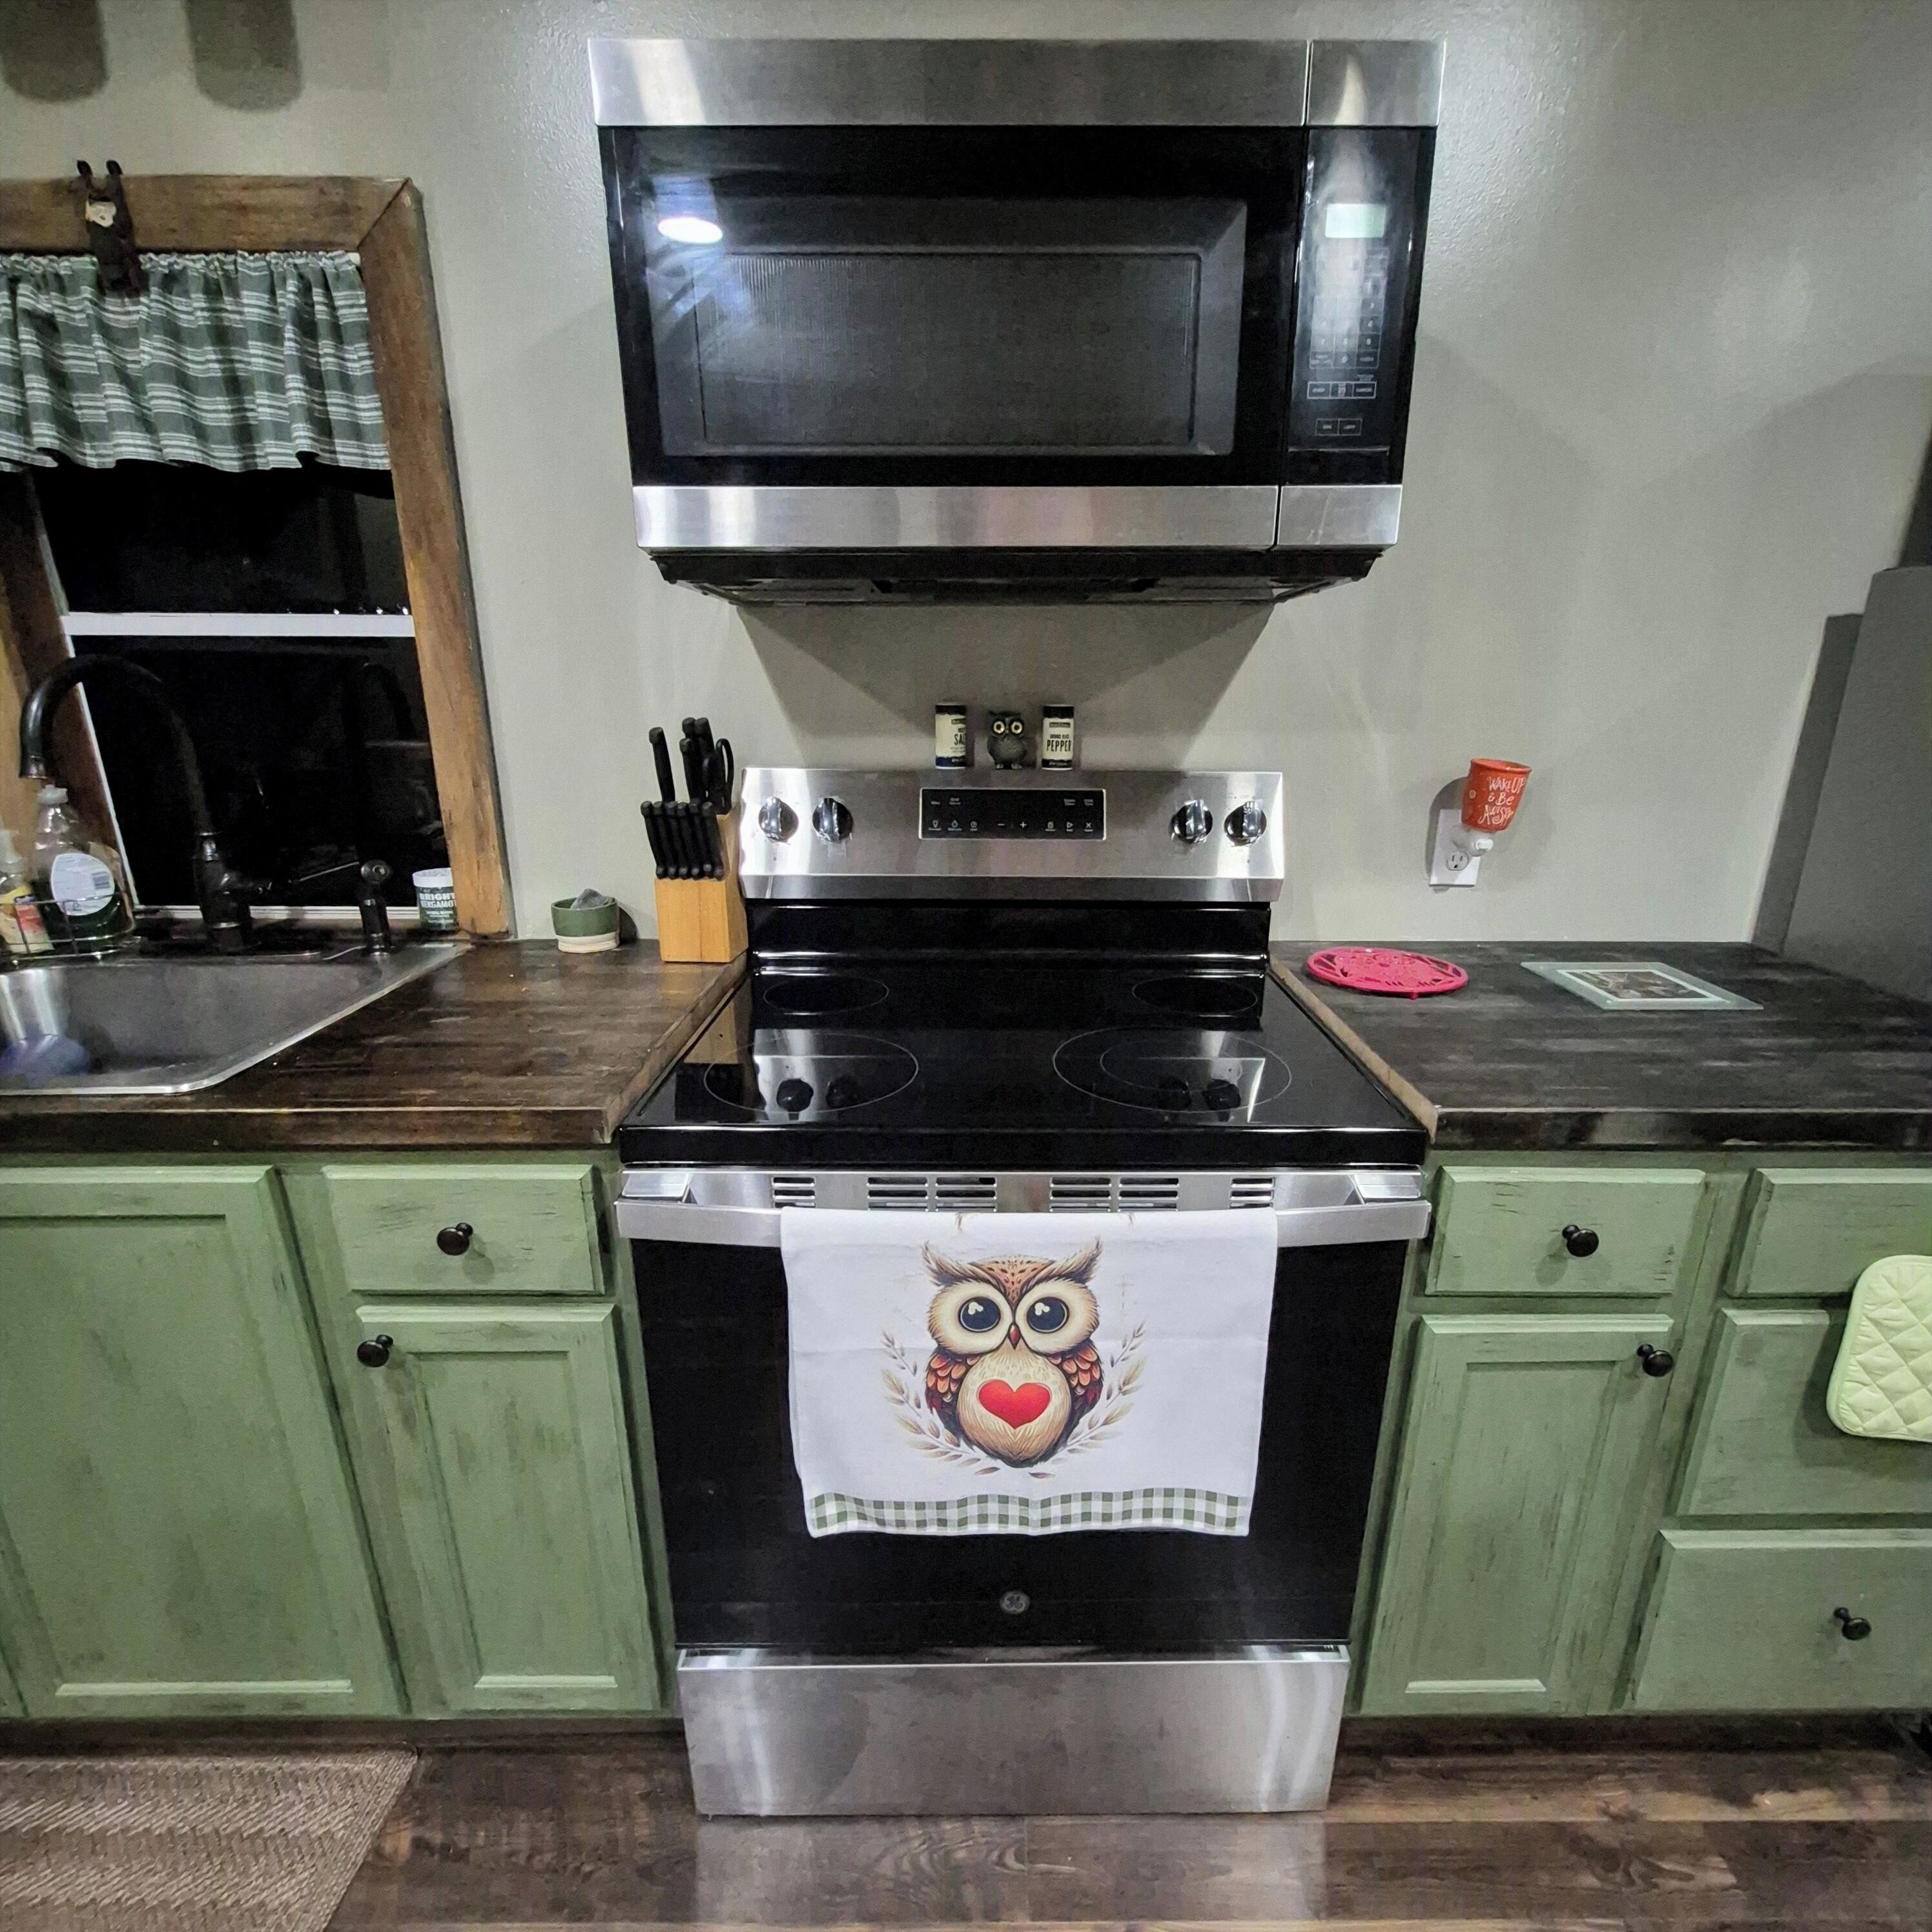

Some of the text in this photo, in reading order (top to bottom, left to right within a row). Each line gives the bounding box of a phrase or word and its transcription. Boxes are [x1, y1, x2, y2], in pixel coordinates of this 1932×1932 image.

[1046, 739, 1071, 752] PEPPER
[1511, 777, 1526, 794] UP
[1488, 792, 1495, 801] &
